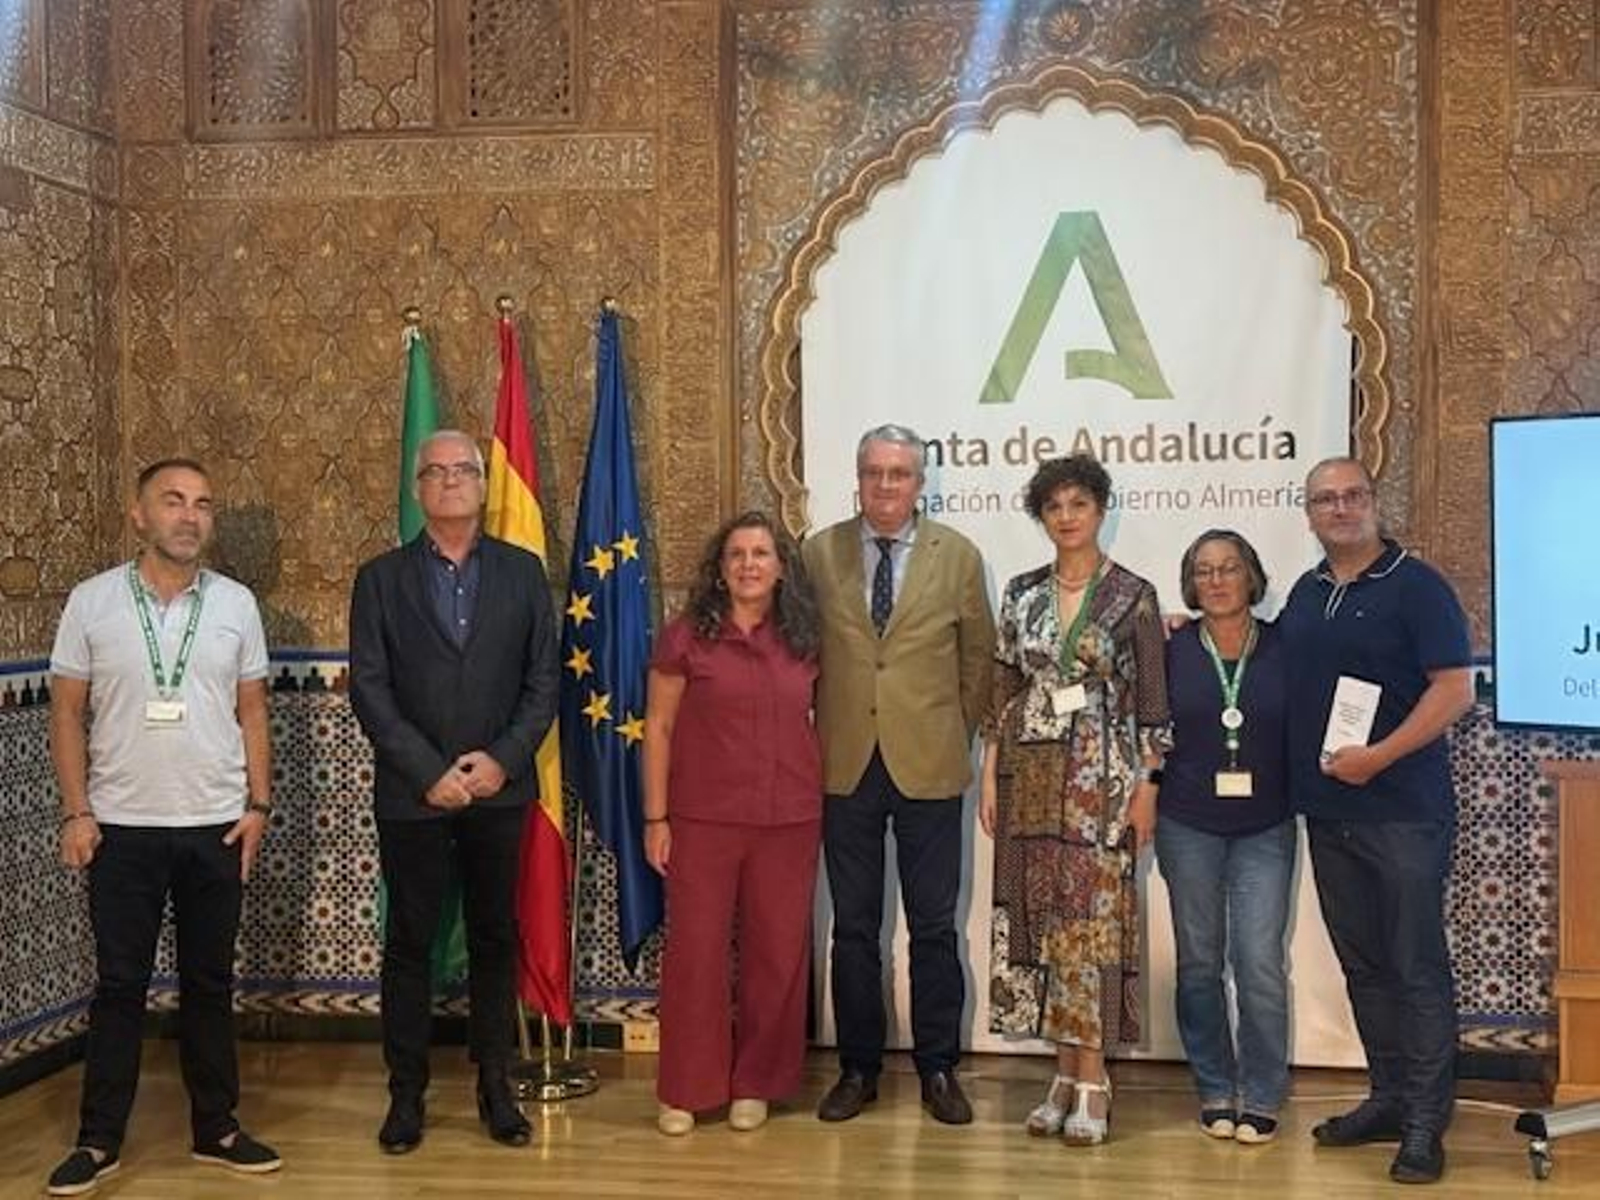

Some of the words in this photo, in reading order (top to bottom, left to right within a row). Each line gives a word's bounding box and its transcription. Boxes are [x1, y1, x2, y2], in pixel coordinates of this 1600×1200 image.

[922, 431, 989, 467] nta
[1003, 426, 1056, 466] de
[1071, 415, 1295, 463] Andalucía
[1106, 486, 1190, 510] bierno
